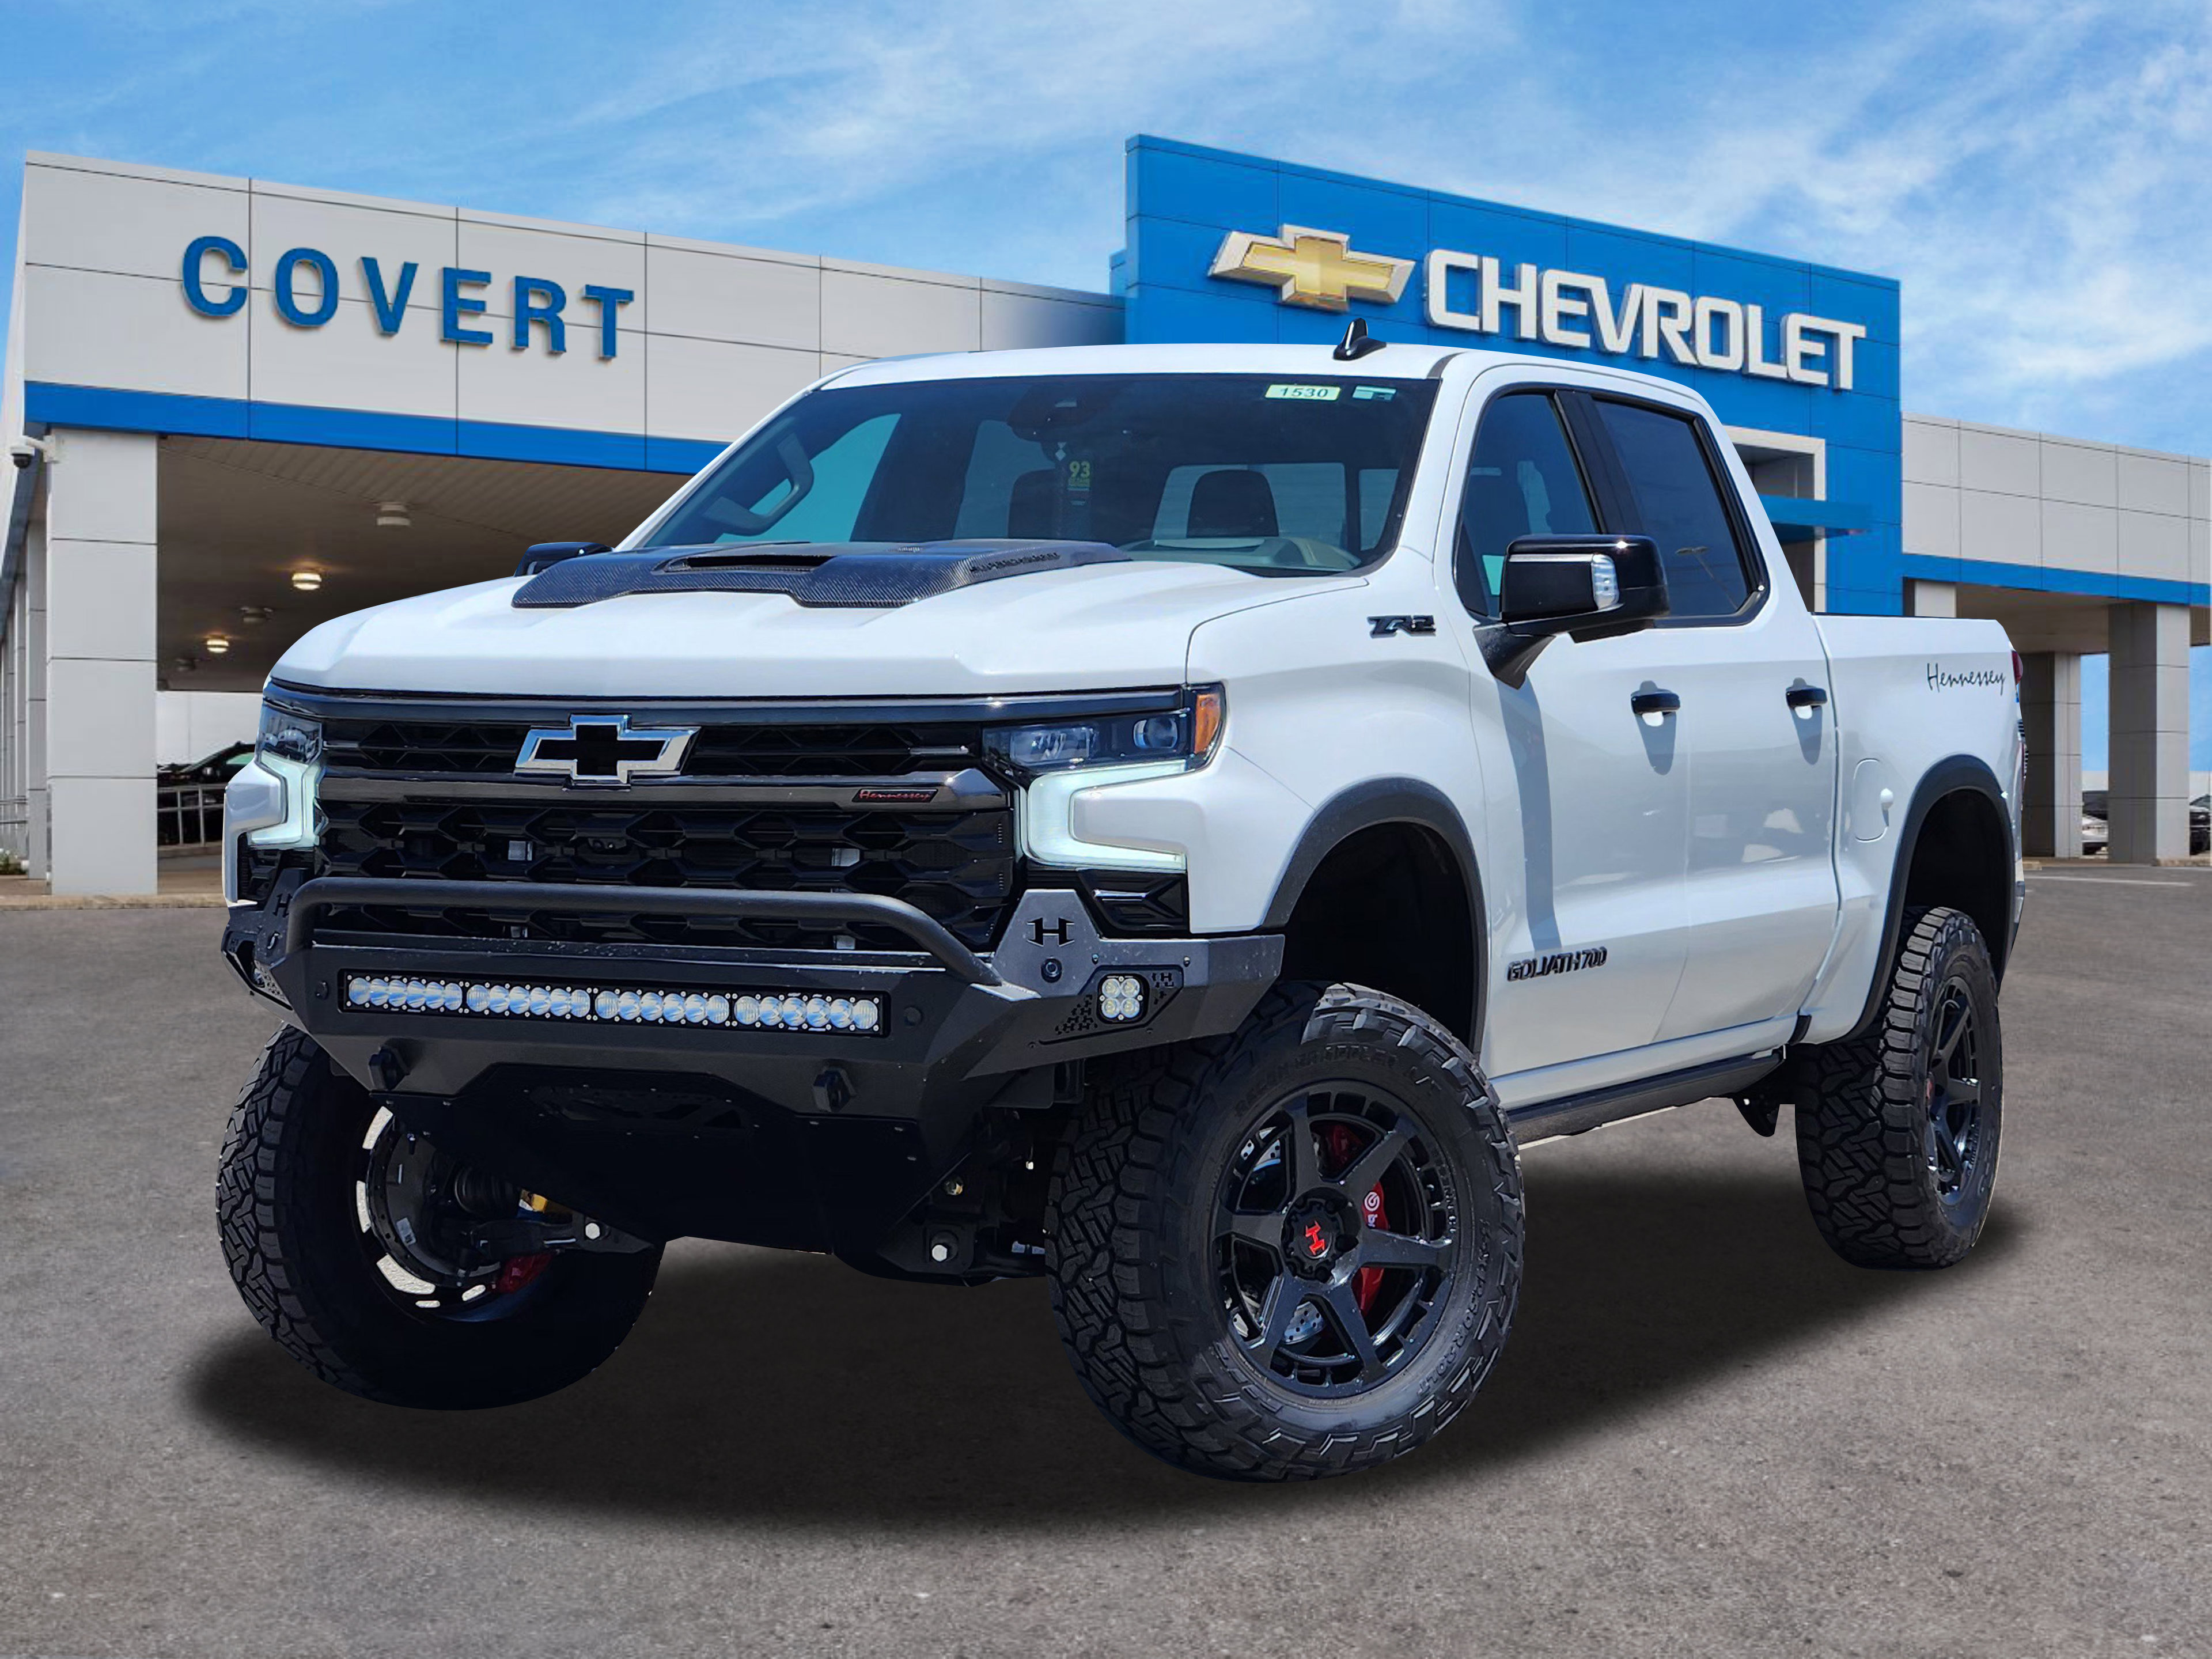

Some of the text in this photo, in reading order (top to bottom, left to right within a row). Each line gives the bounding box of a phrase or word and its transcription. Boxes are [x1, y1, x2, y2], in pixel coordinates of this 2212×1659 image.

[180, 235, 635, 360] COVERT
[1425, 249, 1867, 391] CHEVROLET
[1279, 387, 1330, 398] 1530
[1069, 461, 1090, 478] 93
[1367, 615, 1437, 639] ZR2
[1927, 662, 2007, 696] Hennessey
[859, 789, 931, 802] Hennessey
